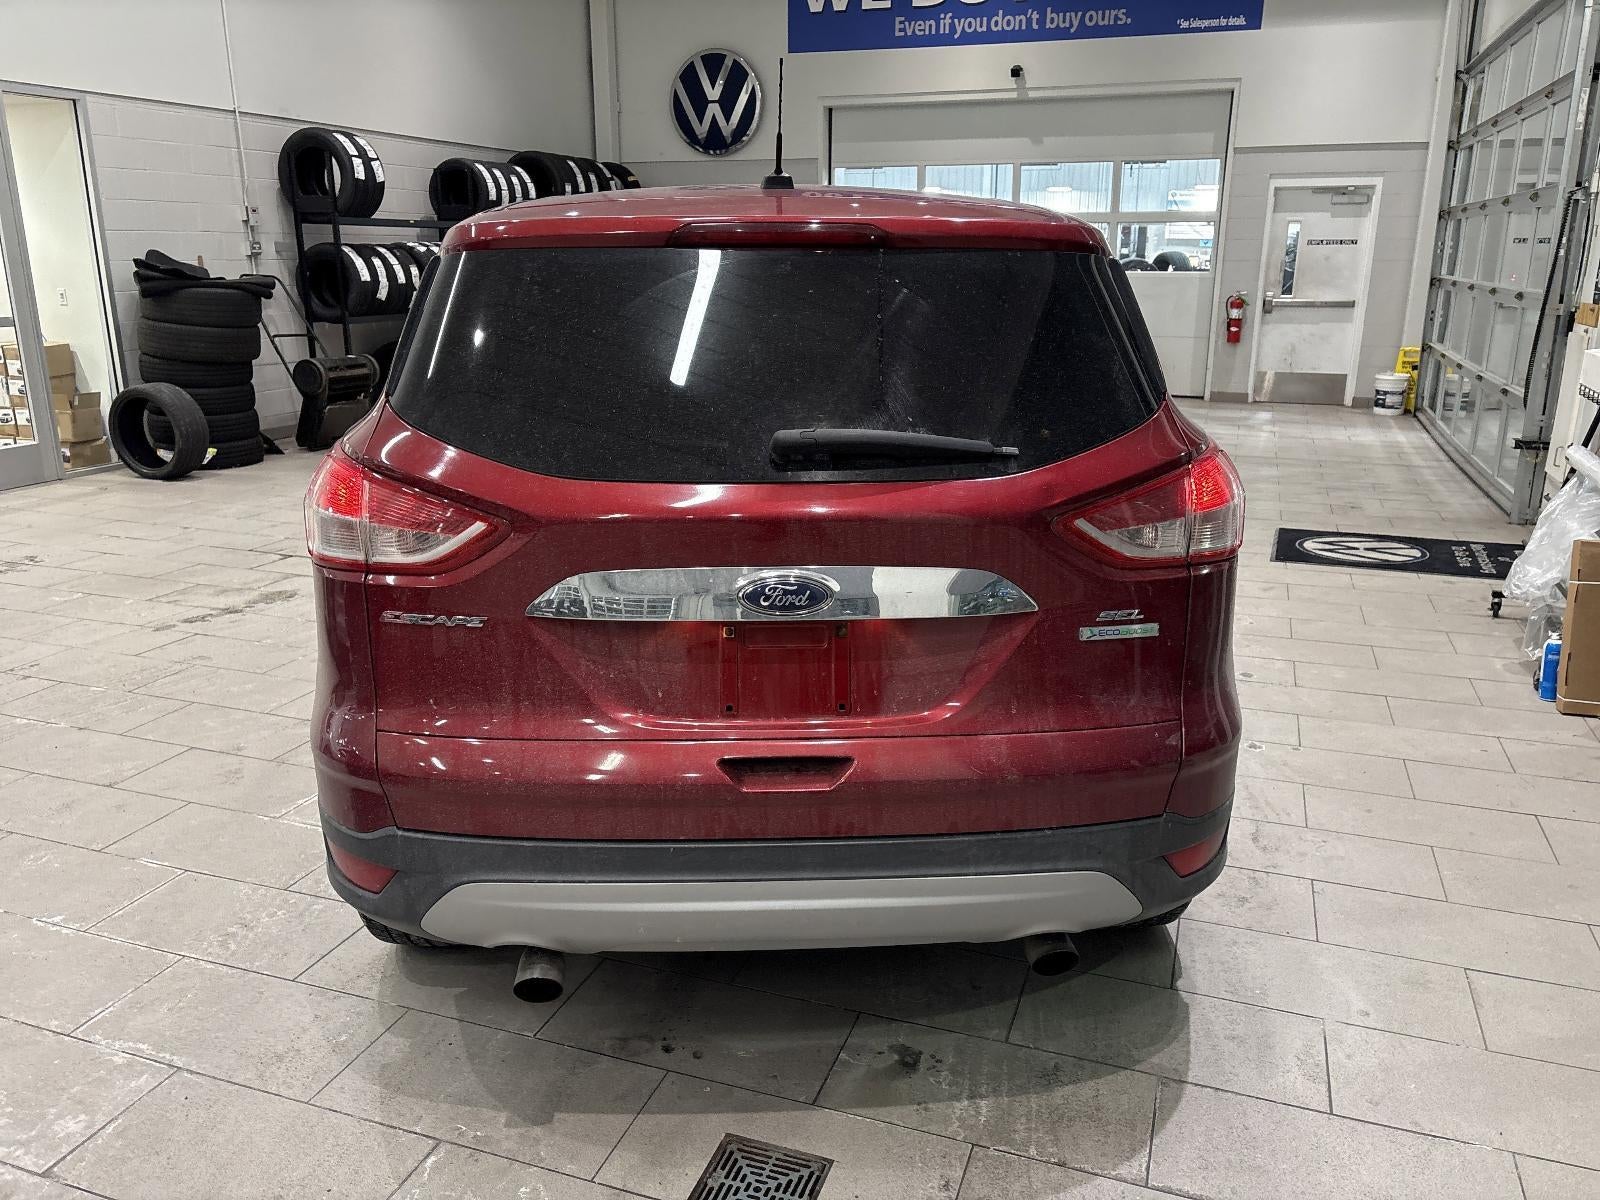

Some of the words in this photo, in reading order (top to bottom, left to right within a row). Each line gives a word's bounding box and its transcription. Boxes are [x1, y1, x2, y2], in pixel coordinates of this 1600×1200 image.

[894, 16, 936, 37] Even
[939, 12, 953, 34] if
[953, 17, 988, 39] you
[990, 8, 1040, 31] don't
[1045, 7, 1083, 33] buy
[1084, 8, 1132, 27] ours.
[1190, 18, 1220, 29] Salesperson
[759, 584, 810, 607] Ford
[381, 610, 488, 627] ESCAPE
[1096, 609, 1144, 621] SEL
